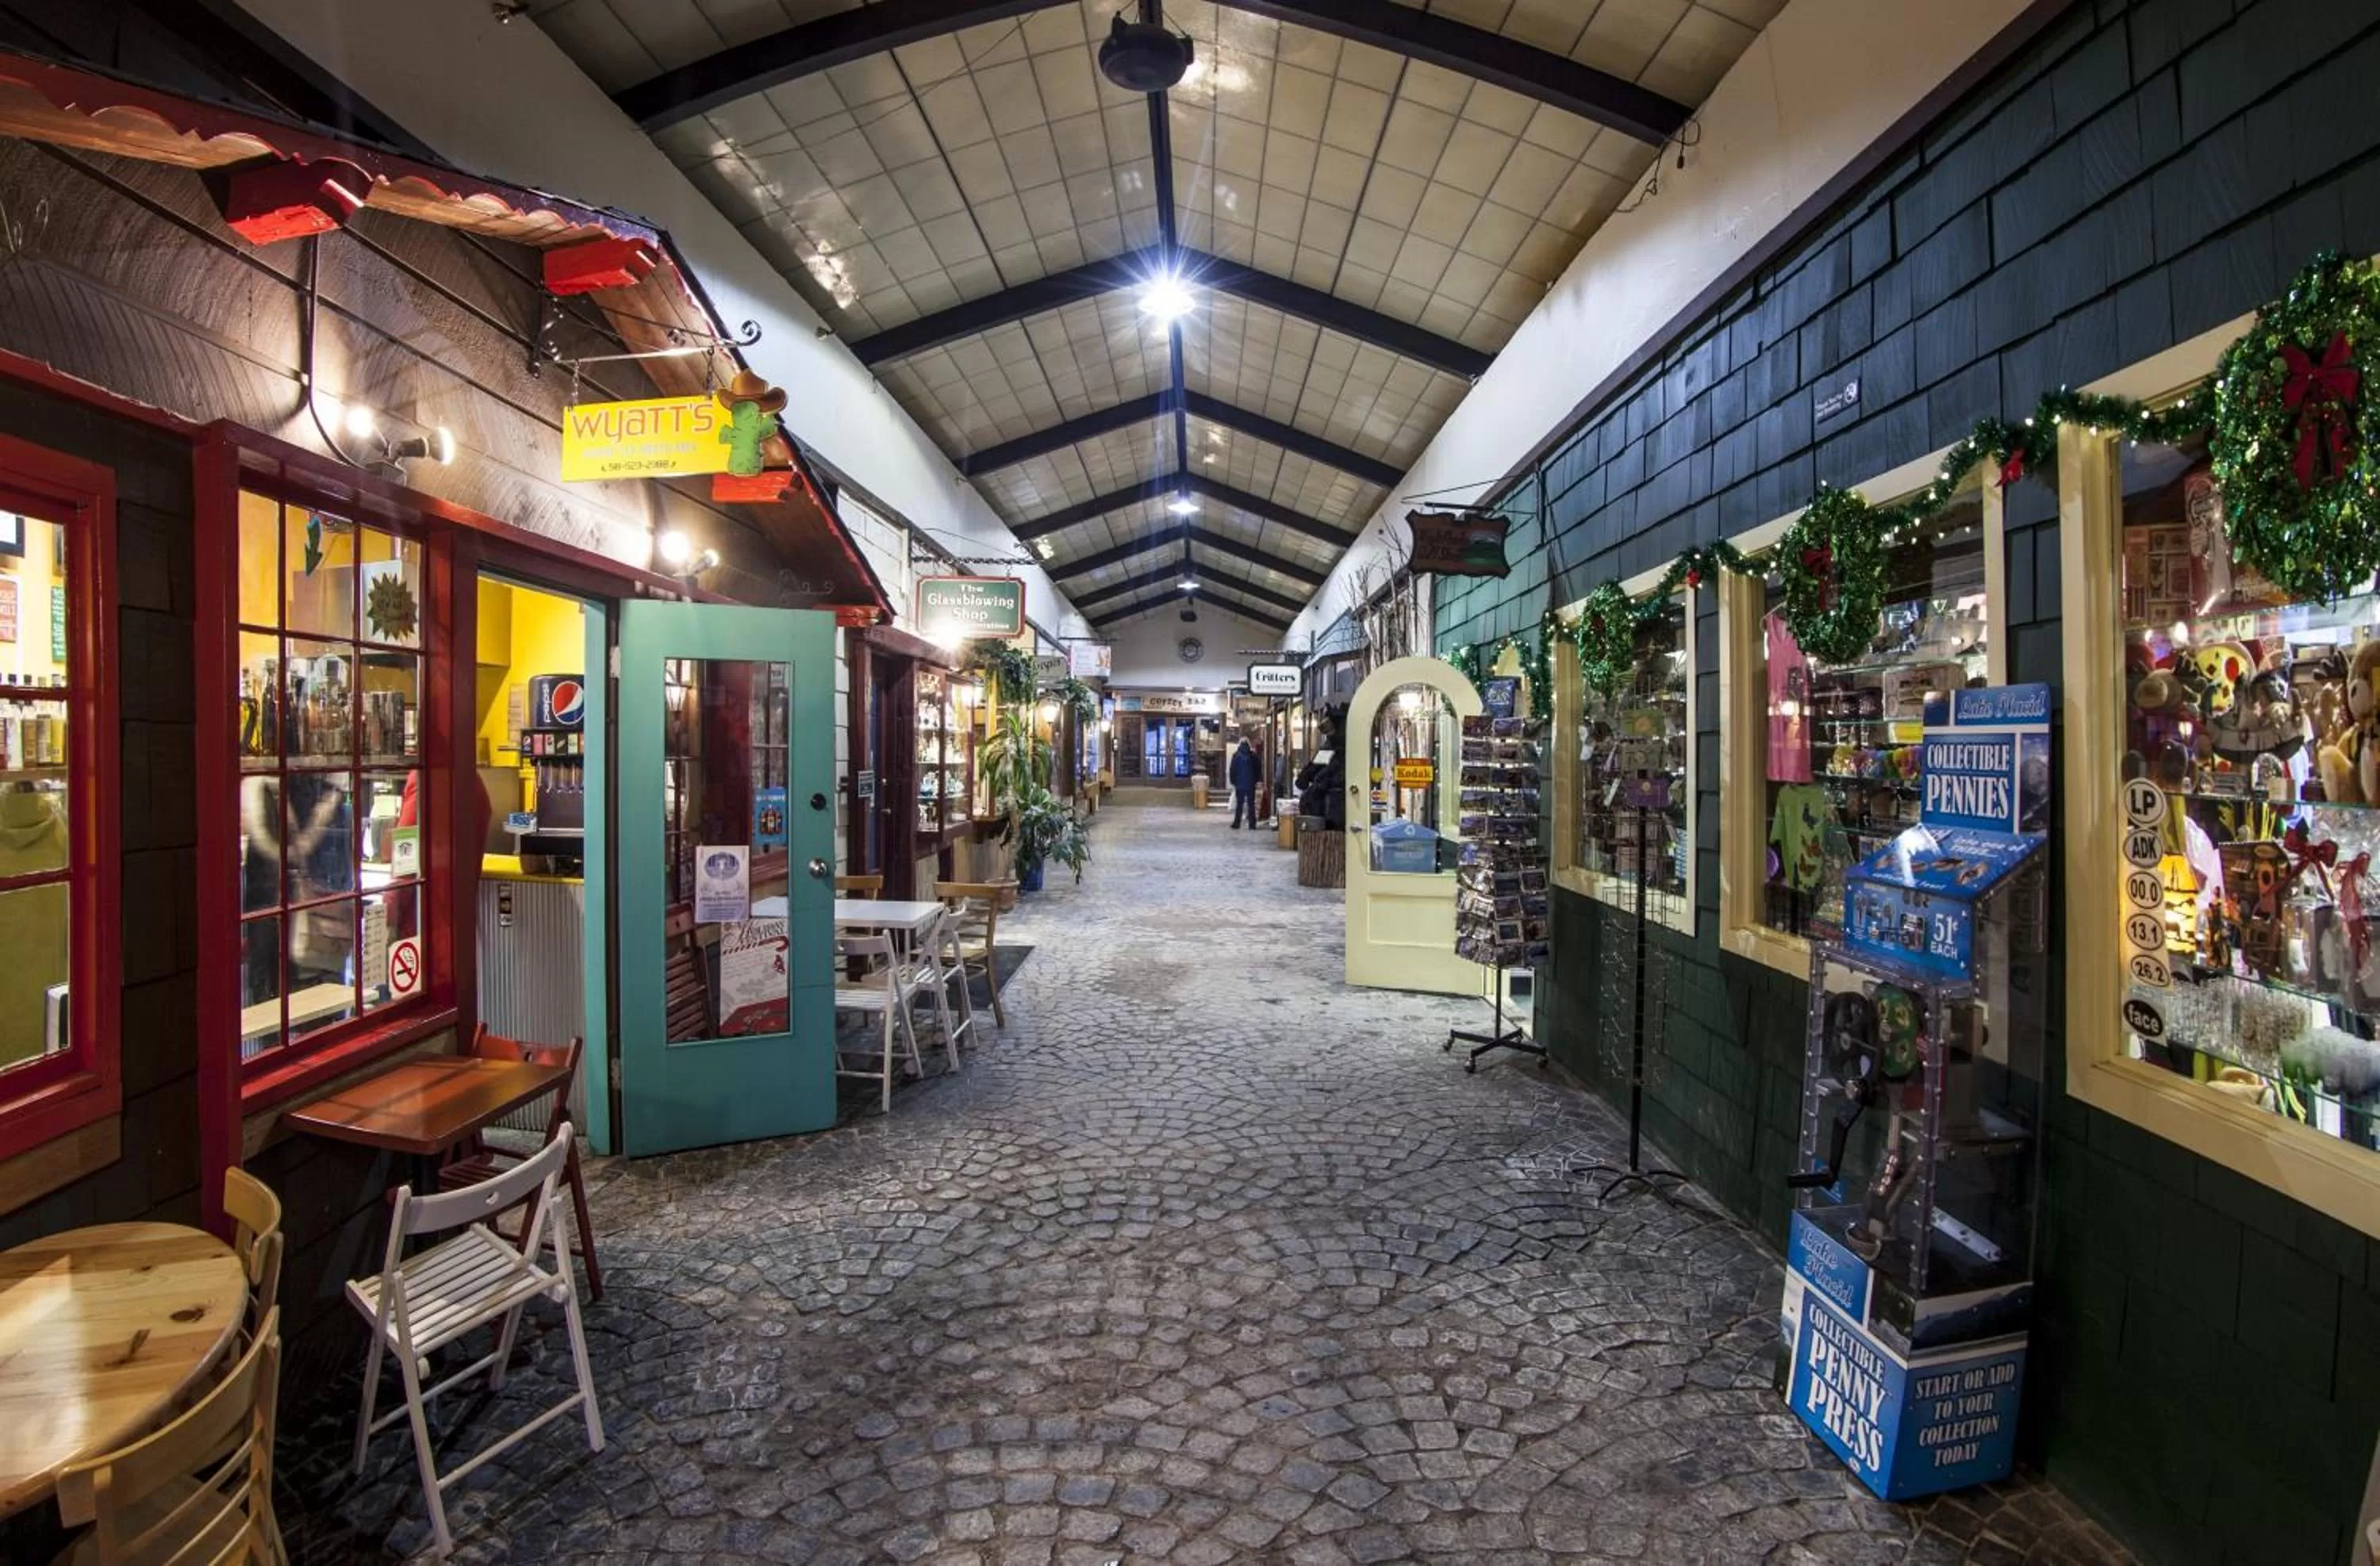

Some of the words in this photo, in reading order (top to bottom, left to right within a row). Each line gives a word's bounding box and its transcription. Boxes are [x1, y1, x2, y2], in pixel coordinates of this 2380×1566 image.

[927, 593, 1015, 609] Glassblowing
[960, 584, 985, 593] The
[953, 608, 988, 622] Shop
[1256, 670, 1296, 682] Critters
[1927, 743, 2010, 772] COLLECTIBLE
[1397, 767, 1431, 778] Kodak
[1925, 773, 2010, 819] PENNIES
[2130, 788, 2156, 816] LP
[2132, 836, 2157, 860] ADK
[2130, 921, 2158, 943] 13.1
[1930, 941, 1958, 960] EACH
[2135, 961, 2166, 983] 26.2
[1809, 1303, 1886, 1383] COLLECTIBLE
[1809, 1328, 1887, 1426] PENNY
[1915, 1372, 1960, 1399] START
[1964, 1368, 1984, 1389] OR
[1987, 1363, 2015, 1385] ADD
[1934, 1401, 1953, 1420] TO
[1956, 1392, 1994, 1418] YOUR
[1806, 1372, 1883, 1472] PRESS
[1919, 1414, 2000, 1448] COLLECTION
[1934, 1442, 1980, 1467] TODAY
